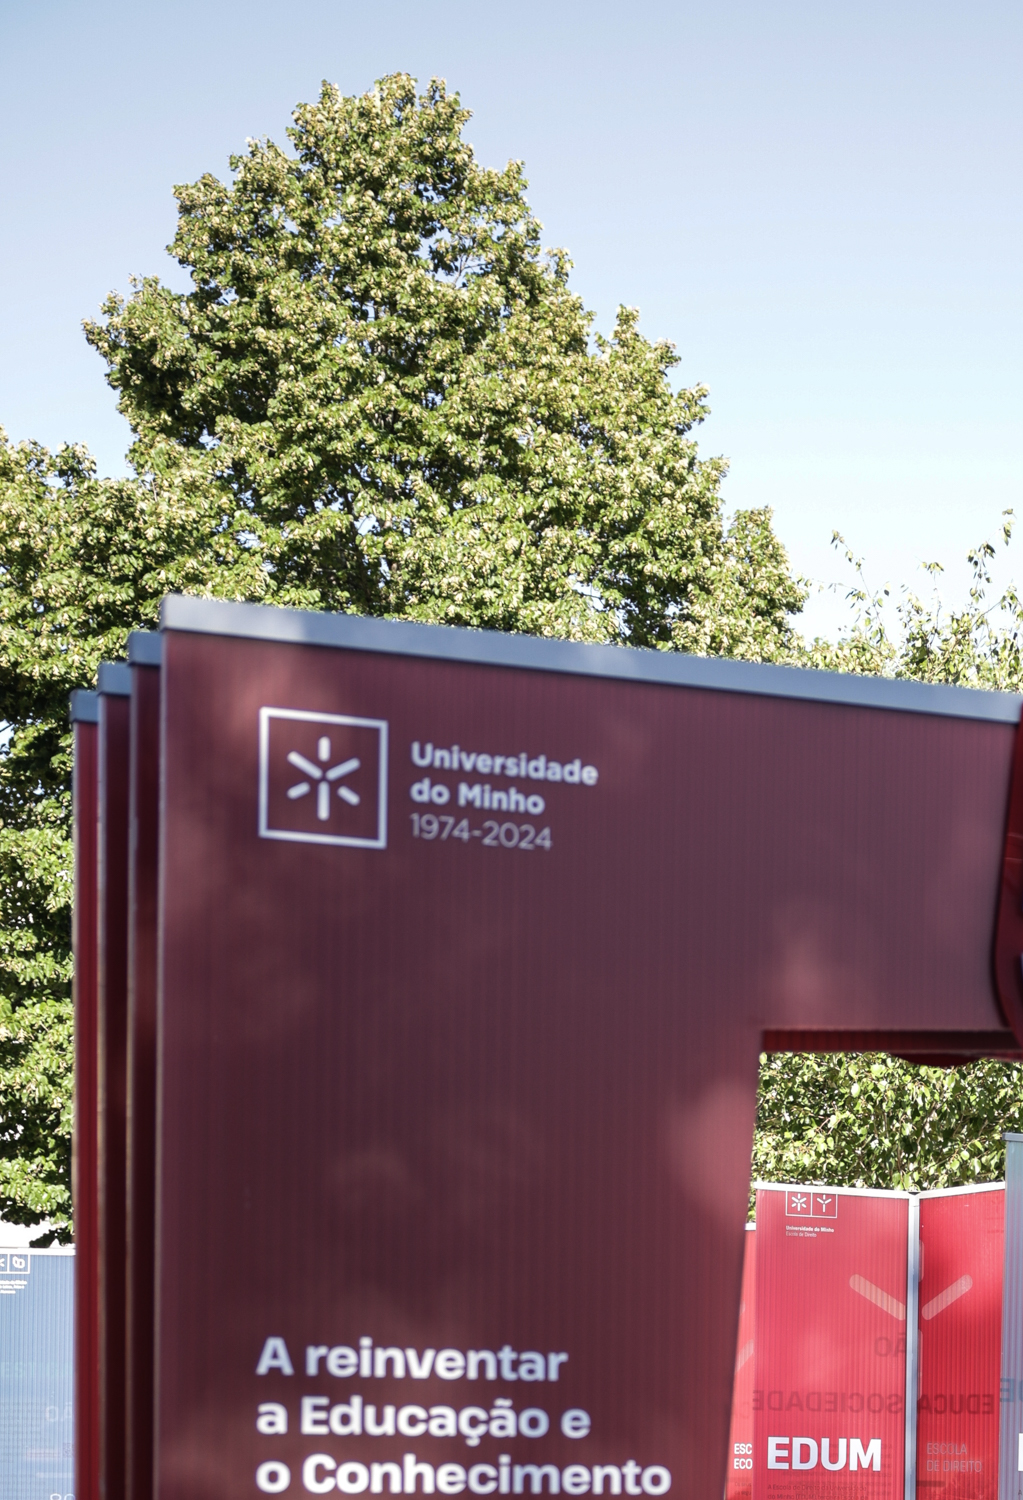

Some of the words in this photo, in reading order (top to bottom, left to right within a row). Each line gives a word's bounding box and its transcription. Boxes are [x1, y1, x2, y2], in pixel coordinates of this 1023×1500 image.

[412, 742, 598, 785] Universidade
[411, 778, 450, 804] do
[458, 783, 545, 814] Minho
[411, 813, 552, 850] 1974-2024
[257, 1338, 293, 1375] A
[307, 1337, 568, 1381] reinventar
[257, 1403, 287, 1434] a
[301, 1395, 548, 1446] Educação
[562, 1410, 590, 1438] e
[767, 1436, 881, 1471] EDUM
[926, 1442, 967, 1455] ESCOLA
[926, 1459, 940, 1472] DE
[943, 1460, 982, 1473] DIREITO
[256, 1461, 290, 1493] o
[302, 1453, 671, 1495] Conhecimento
